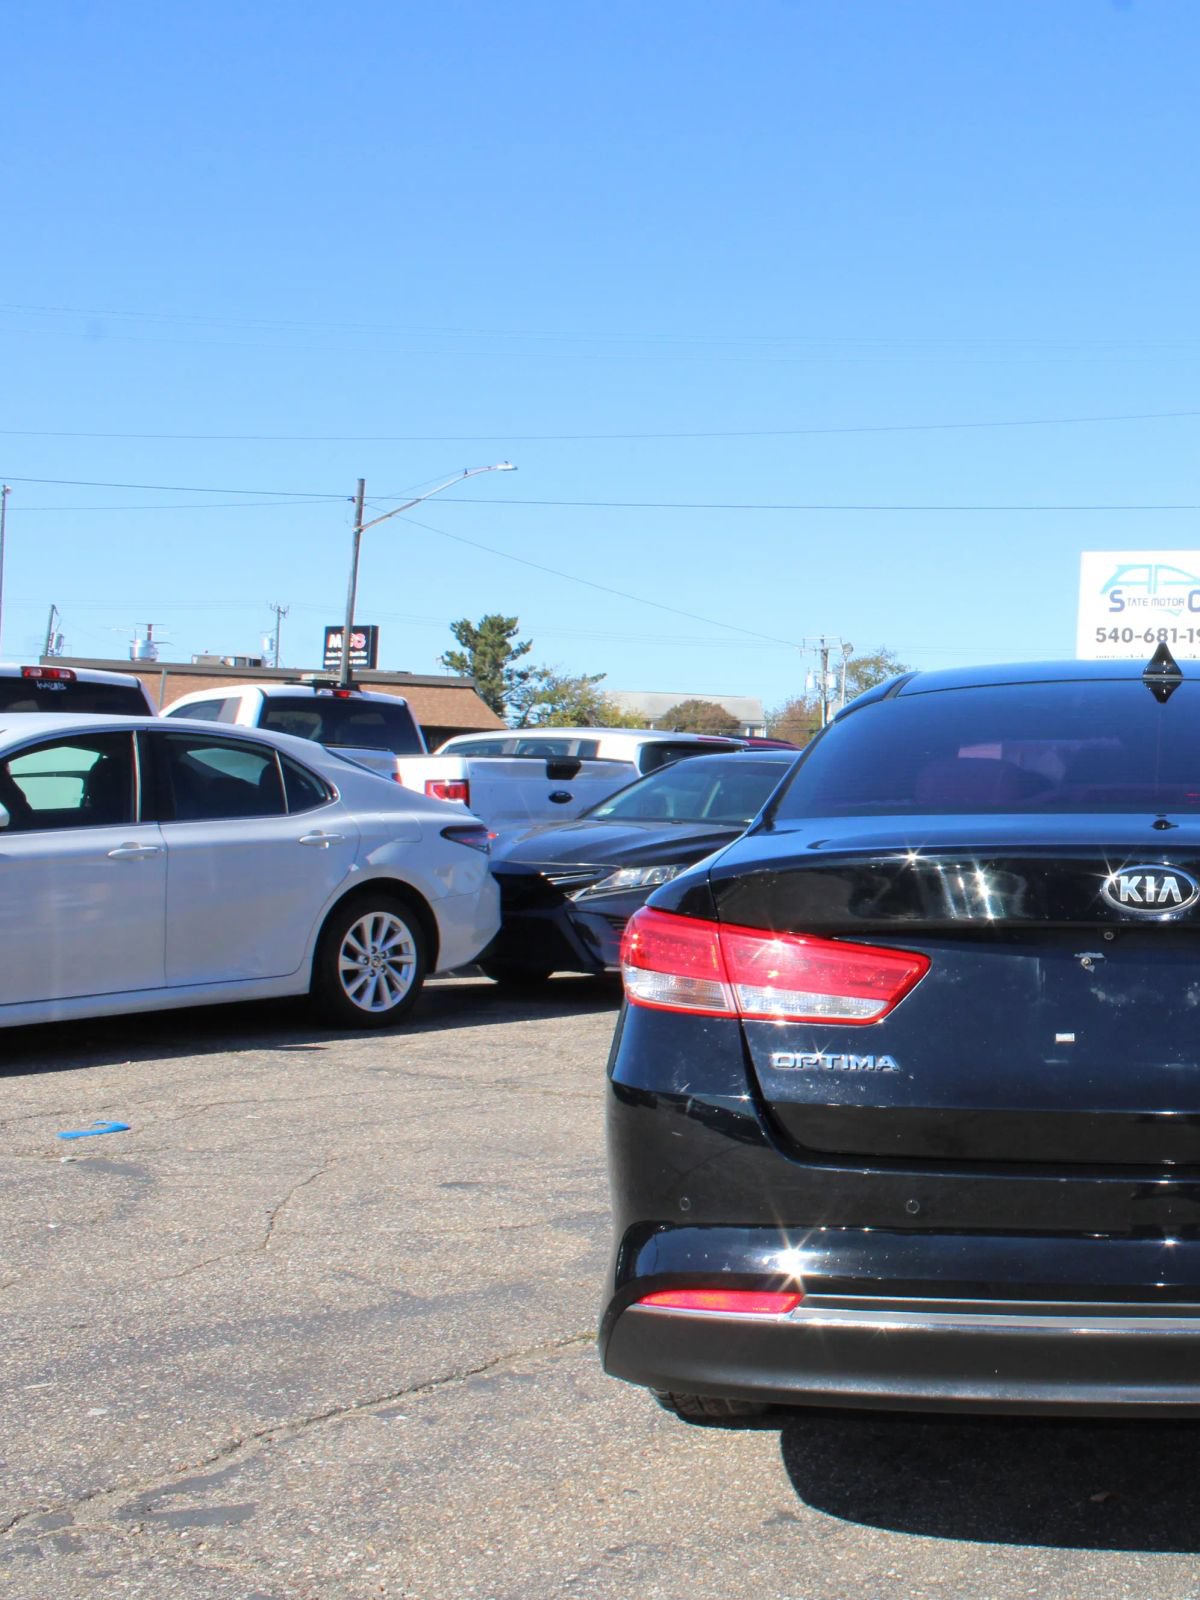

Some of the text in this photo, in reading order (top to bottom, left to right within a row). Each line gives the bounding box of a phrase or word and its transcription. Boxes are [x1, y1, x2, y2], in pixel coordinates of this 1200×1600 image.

[1109, 590, 1149, 612] STATE
[1119, 876, 1183, 902] KIA
[771, 1052, 899, 1072] OPTIMA
